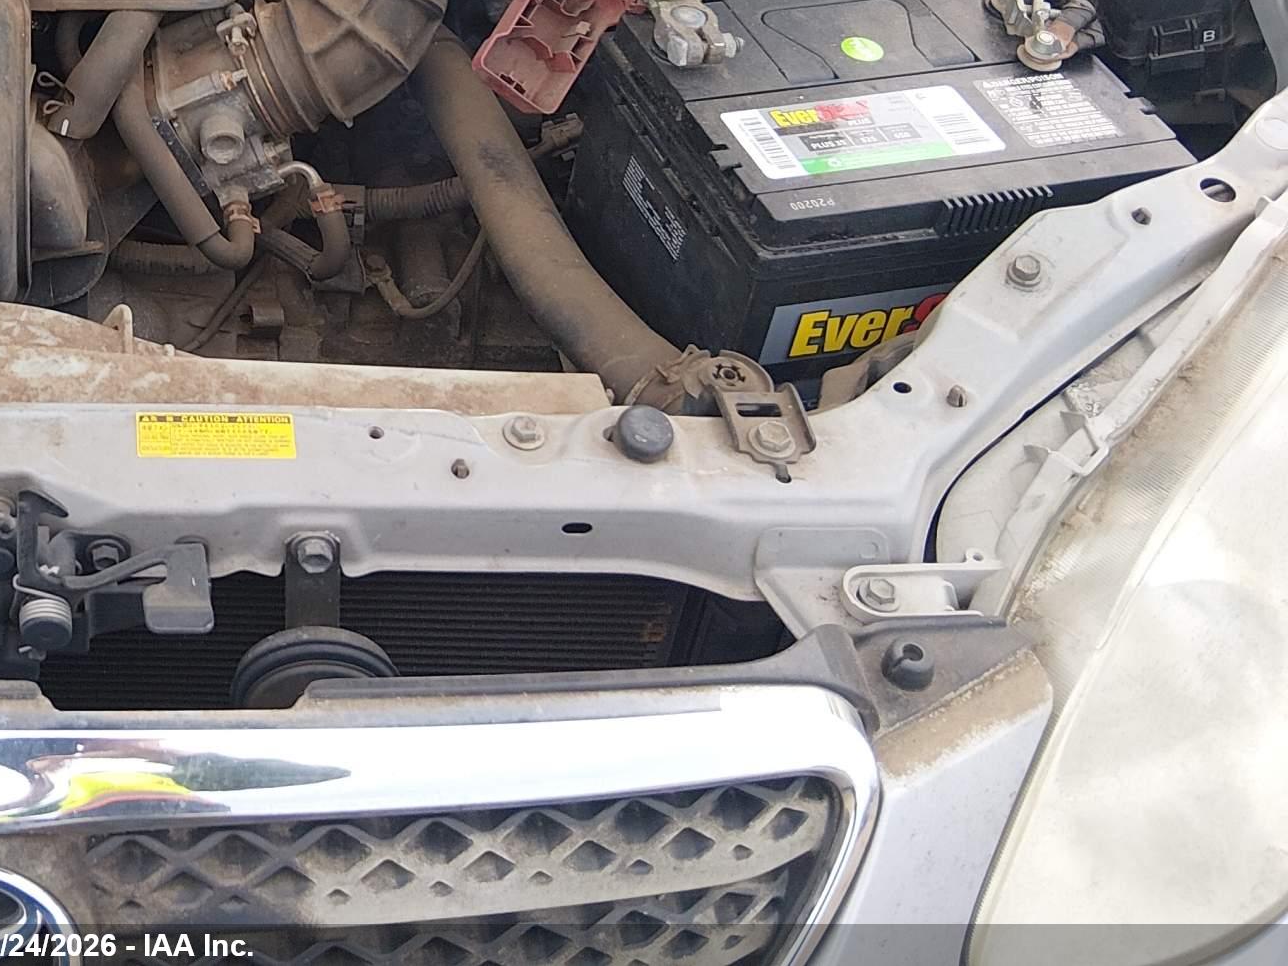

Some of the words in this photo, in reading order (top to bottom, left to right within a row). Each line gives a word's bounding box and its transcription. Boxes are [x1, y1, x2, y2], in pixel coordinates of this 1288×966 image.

[1202, 29, 1217, 43] B
[181, 415, 229, 423] CAUTION
[236, 415, 290, 424] ATTENTION
